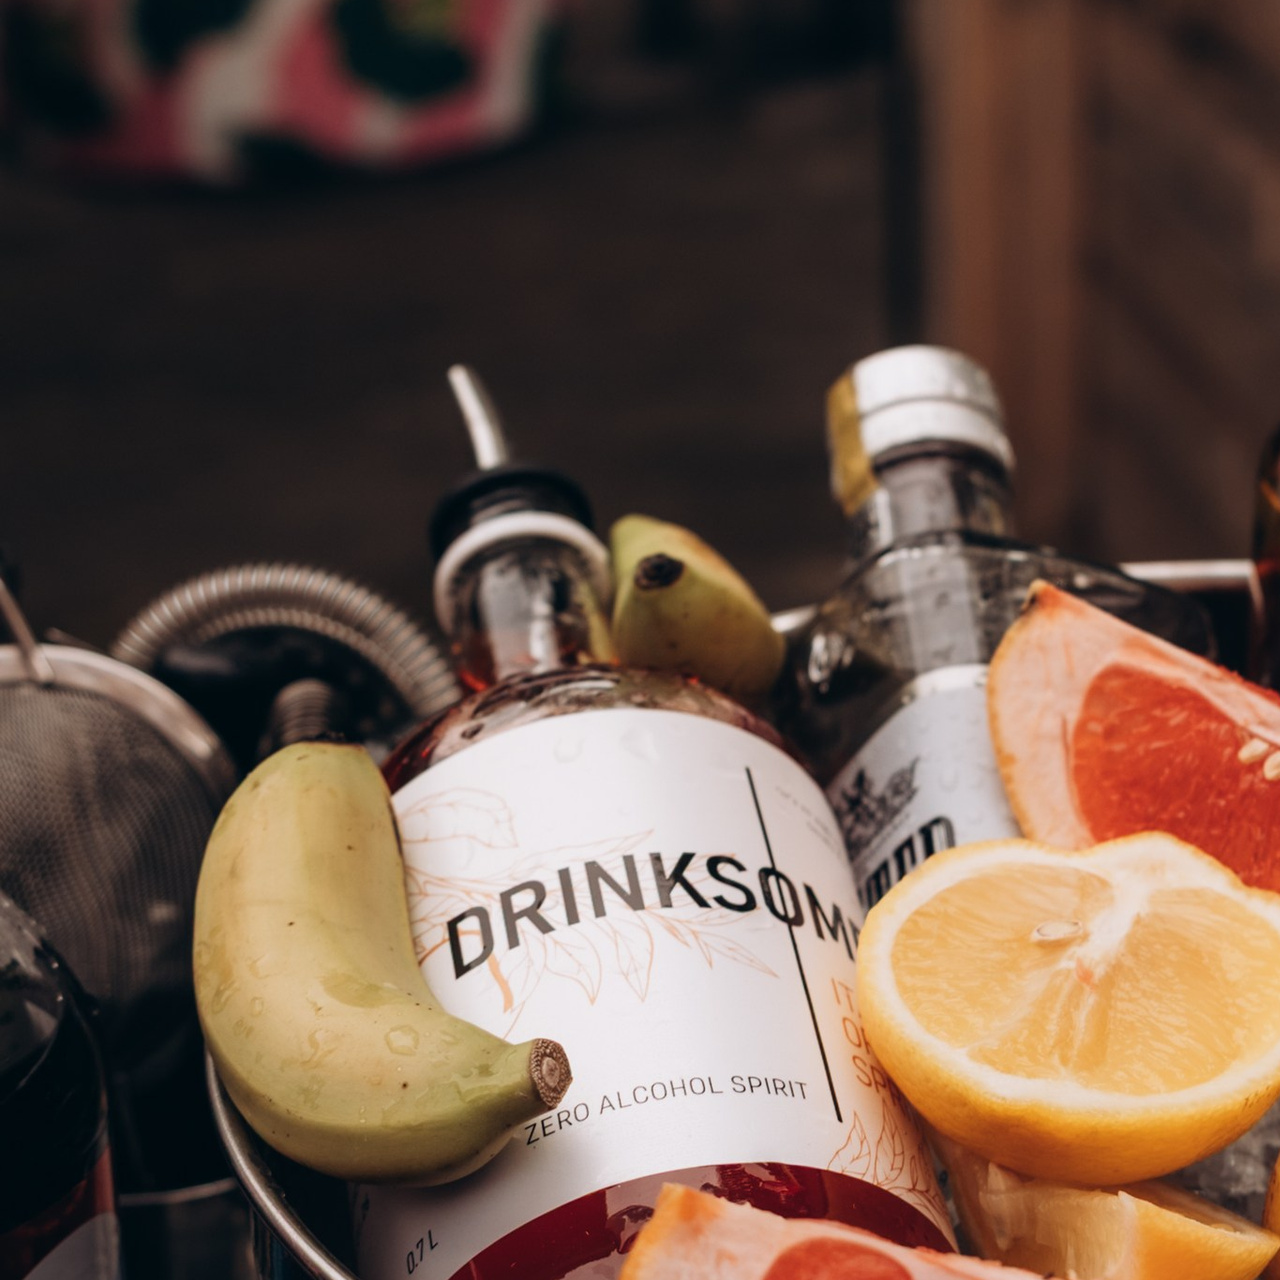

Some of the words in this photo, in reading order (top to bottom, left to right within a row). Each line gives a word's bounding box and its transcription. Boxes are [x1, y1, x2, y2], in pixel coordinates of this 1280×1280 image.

[524, 1102, 590, 1146] ZERO
[599, 1076, 724, 1115] ALCOHOL
[730, 1075, 808, 1100] SPIRIT
[406, 1238, 424, 1274] 0.7
[428, 1229, 439, 1250] L
